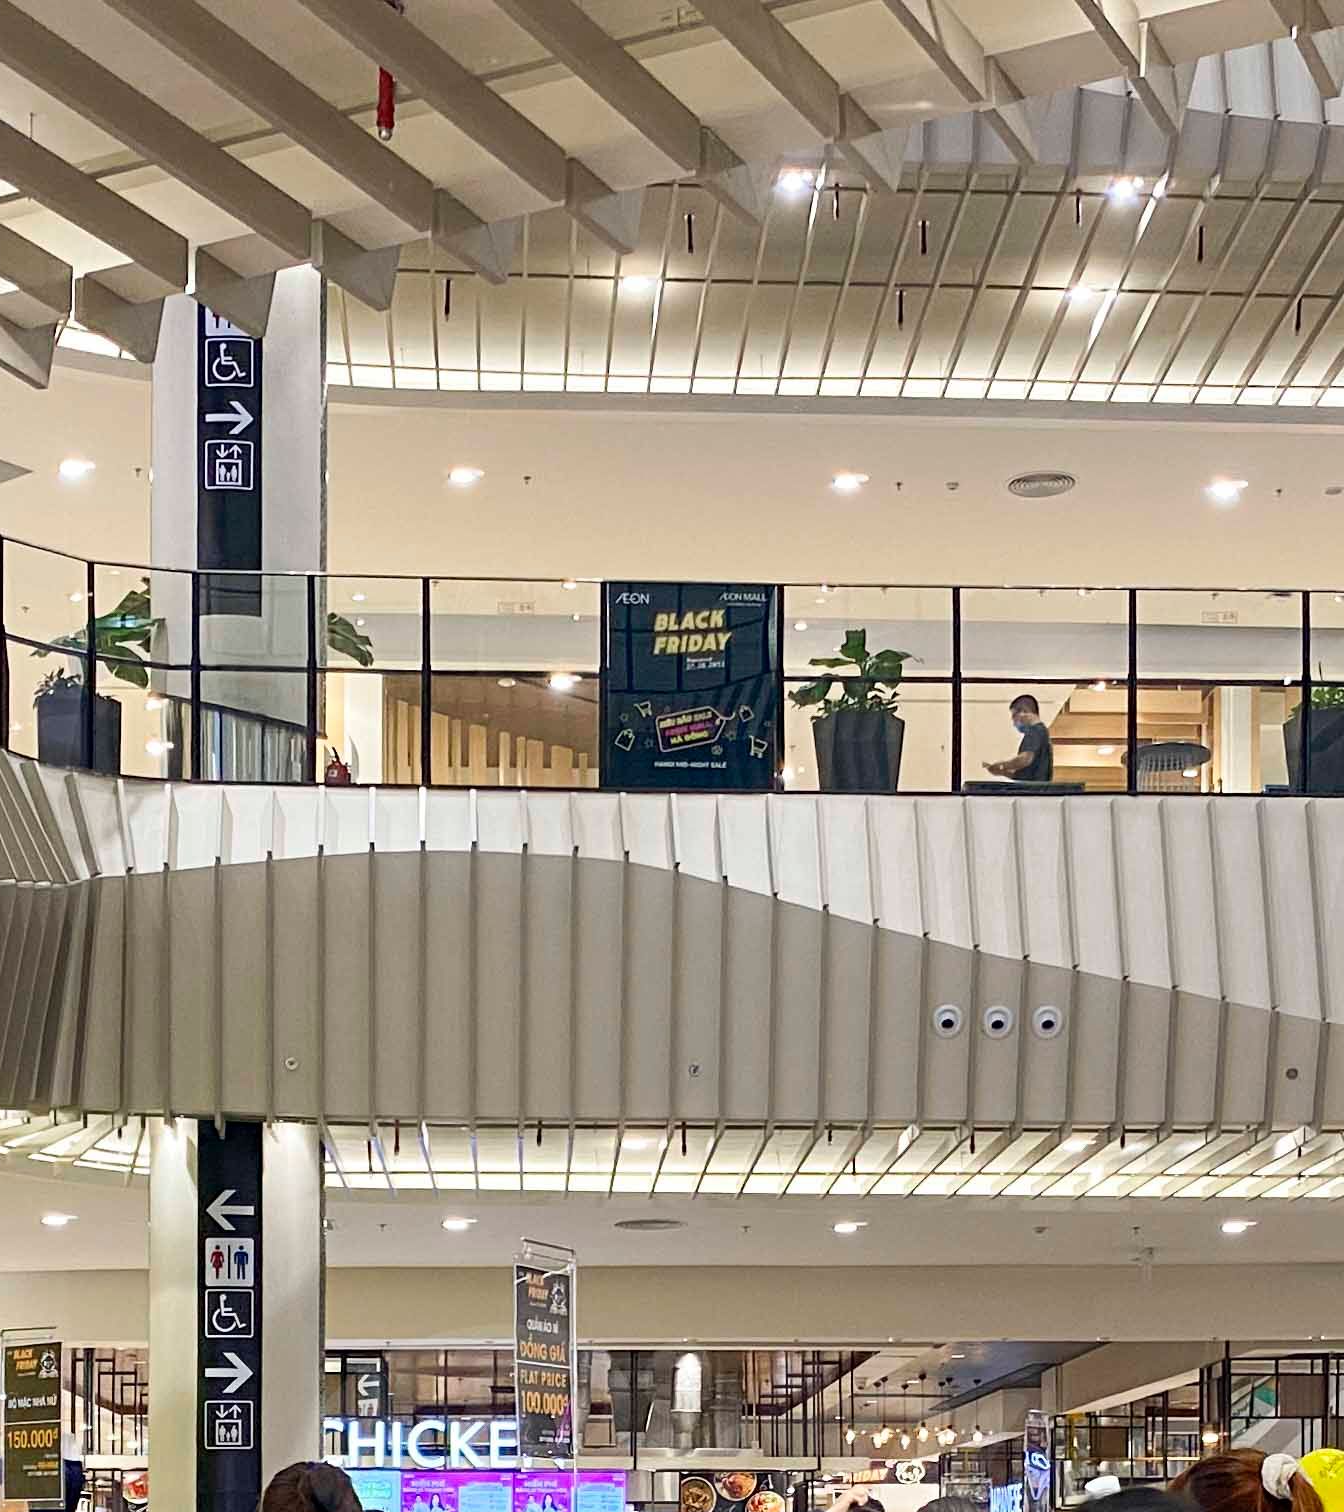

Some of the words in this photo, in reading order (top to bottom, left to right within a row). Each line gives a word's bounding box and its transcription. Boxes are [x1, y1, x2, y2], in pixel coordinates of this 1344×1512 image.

[653, 608, 726, 632] BLACK
[653, 632, 732, 656] FRIDAY
[519, 1368, 540, 1387] FLAT
[541, 1369, 568, 1389] PRICE
[323, 1420, 564, 1469] CHICKE
